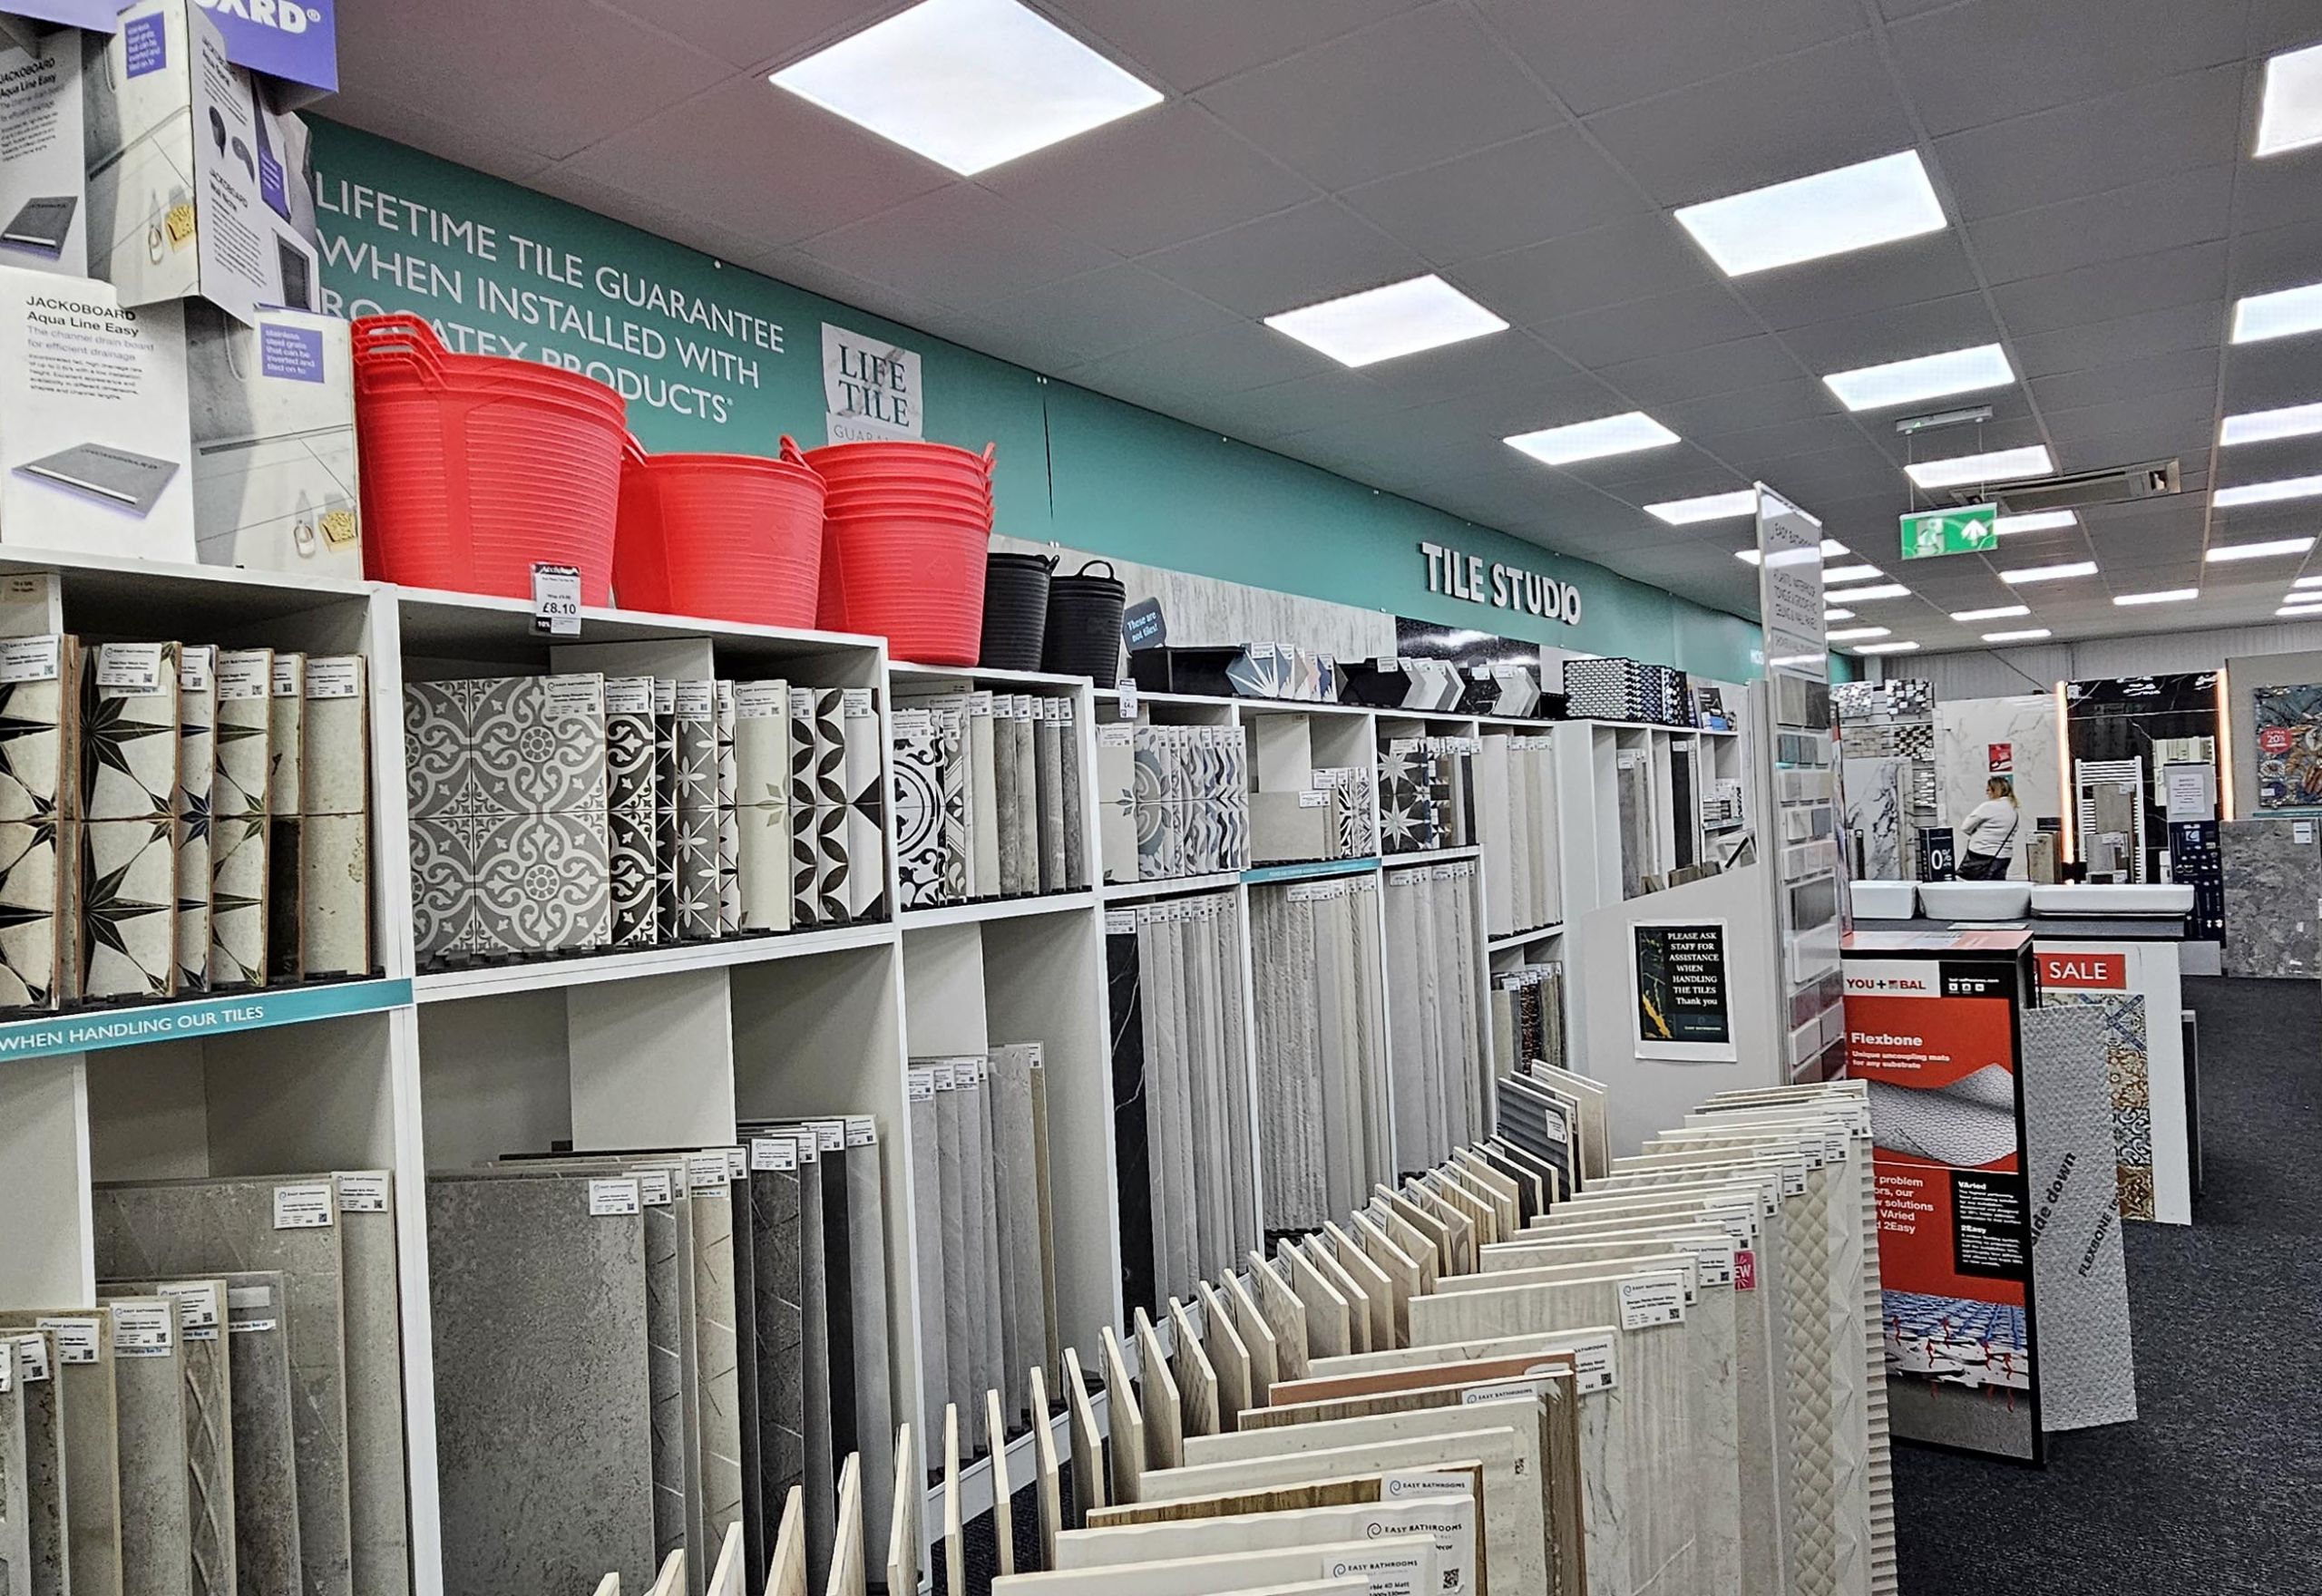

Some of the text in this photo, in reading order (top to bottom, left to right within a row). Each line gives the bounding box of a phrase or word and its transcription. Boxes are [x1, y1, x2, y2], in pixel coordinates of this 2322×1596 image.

[317, 171, 496, 261] LIFETIME
[509, 234, 584, 288] TILE
[595, 266, 785, 354] GUARANTEE
[26, 296, 136, 321] JACKOBOARD
[316, 228, 462, 304] WHEN
[478, 277, 667, 360] INSTALLED
[675, 336, 760, 389] WITH
[27, 311, 139, 338] Aqua Line Easy
[838, 344, 906, 394] LIFE
[838, 379, 910, 427] TILE
[1422, 541, 1582, 626] TILE STUDIO
[542, 602, 577, 615] £8.10
[1127, 610, 1157, 632] These are
[1131, 631, 1144, 644] not
[1667, 932, 1717, 940] PLEASE ASK
[1669, 954, 1720, 962] ASSISTANCE
[1676, 965, 1704, 973] WHEN
[2050, 961, 2108, 980] SALE
[1673, 975, 1718, 983] HANDLING
[1847, 978, 1874, 989] YOU
[1900, 979, 1927, 990] BAL
[1673, 986, 1717, 994] THE TILES
[1676, 998, 1718, 1007] Thank you
[0, 1006, 265, 1051] WHEN HANDLING OUR TILES
[1851, 1032, 1924, 1047] Flexbone
[1852, 1050, 1951, 1063] Unique uncoupling mats
[1853, 1059, 1864, 1067] for
[1882, 1060, 1922, 1070] substrate
[1878, 1176, 1924, 1188] problem
[2045, 1152, 2077, 1204] down
[1896, 1189, 1915, 1198] our
[1885, 1200, 1935, 1212] solutions
[1880, 1209, 1916, 1221] VAried
[1883, 1221, 1917, 1235] 2Easy
[2078, 1212, 2113, 1278] FLEXBONE
[1409, 1523, 1463, 1533] BATHROOMS
[1370, 1560, 1419, 1570] BATHROOMS
